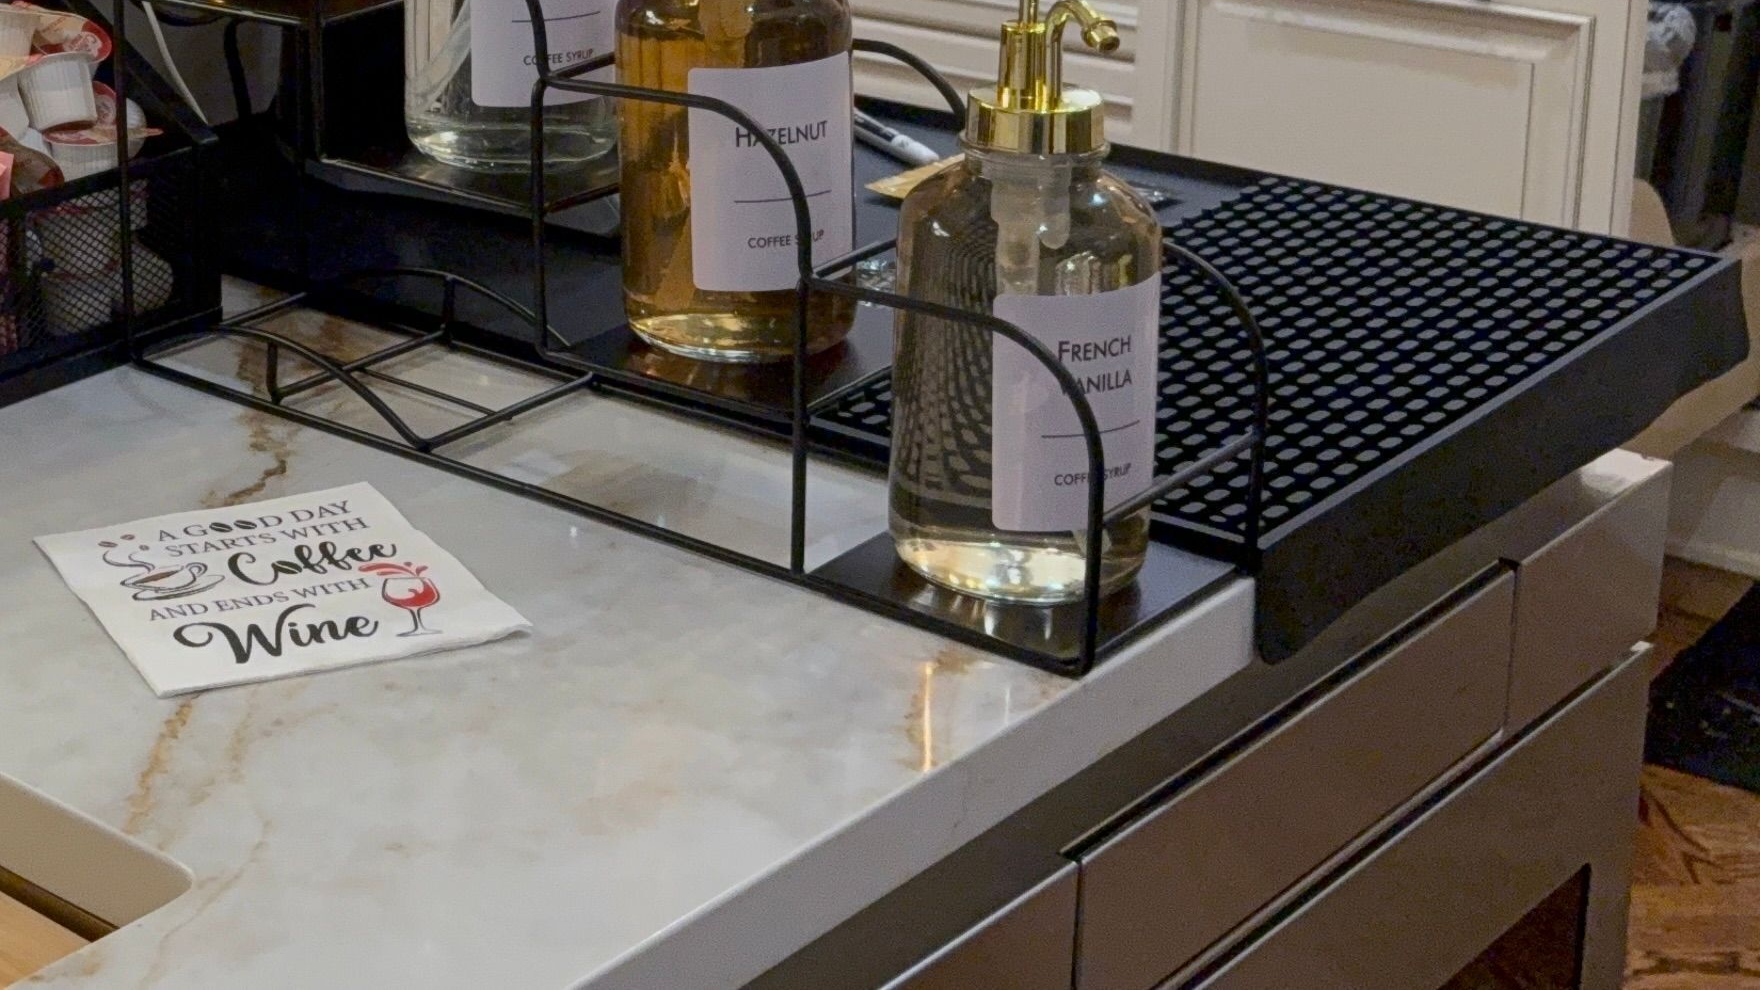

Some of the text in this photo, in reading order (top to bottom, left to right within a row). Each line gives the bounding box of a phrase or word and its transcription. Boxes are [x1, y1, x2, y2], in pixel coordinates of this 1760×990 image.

[747, 234, 791, 249] COFFEE
[1058, 334, 1132, 362] FRENCH
[1061, 368, 1133, 395] ANILLA
[1054, 472, 1097, 486] COFF
[158, 500, 352, 542] A GOOD DAY
[164, 516, 371, 558] STARTS WITH
[227, 539, 399, 587] Coffee
[149, 577, 373, 622] AND ENDS WITH
[173, 602, 380, 665] Wine
